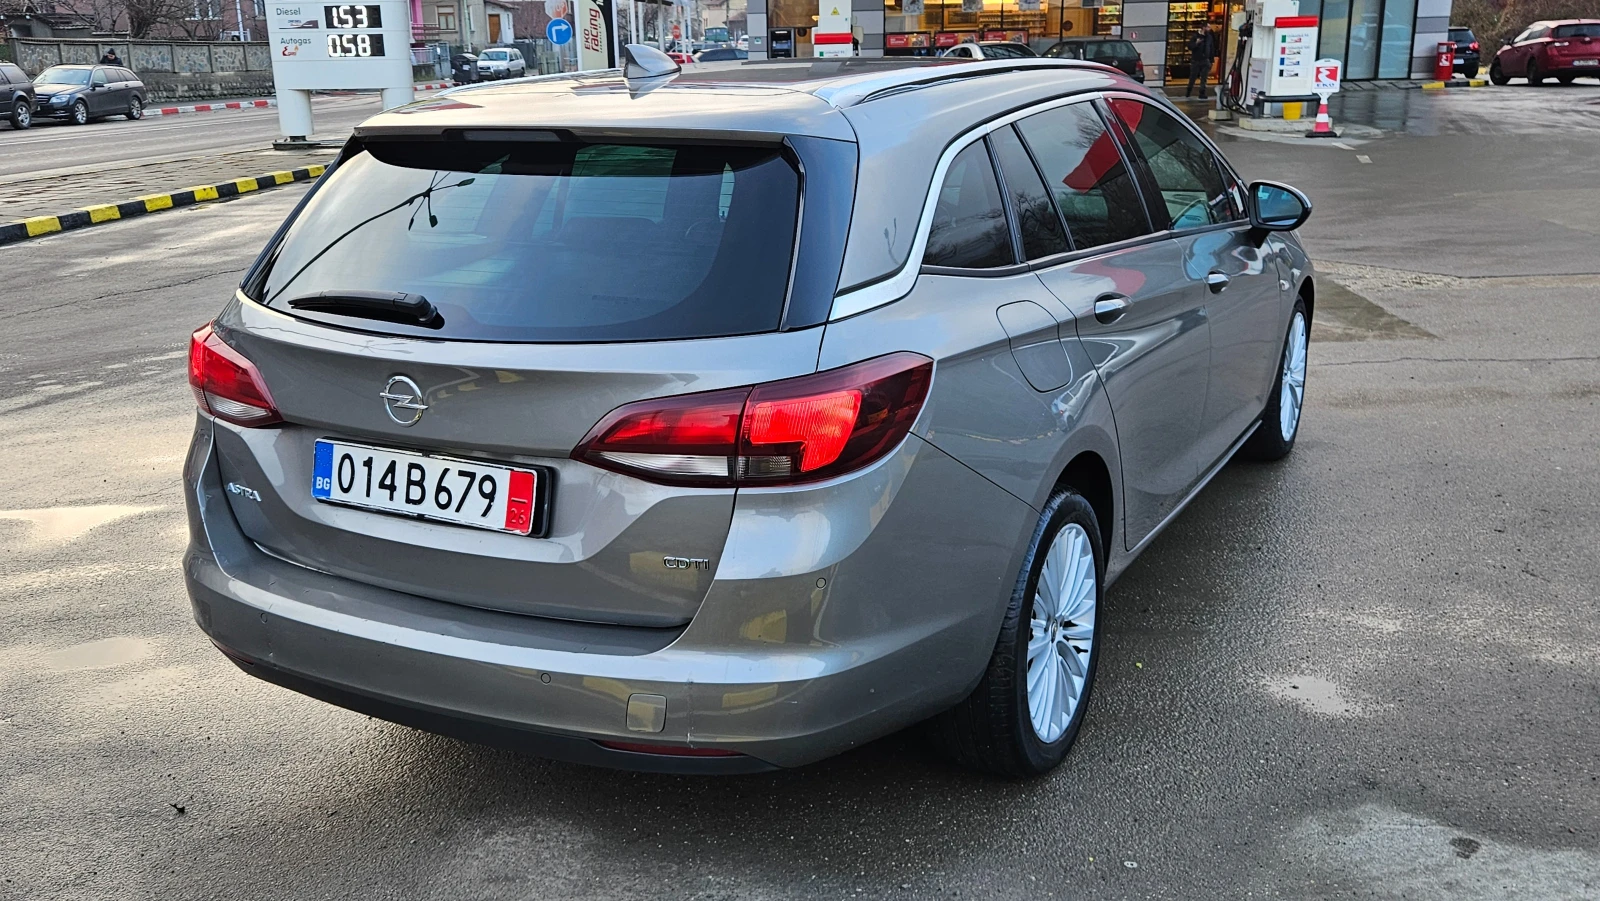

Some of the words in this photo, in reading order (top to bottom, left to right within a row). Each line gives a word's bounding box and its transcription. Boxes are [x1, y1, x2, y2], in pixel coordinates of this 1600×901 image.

[276, 8, 301, 16] Diesel
[589, 8, 600, 52] racing
[281, 37, 311, 46] Autogas
[227, 482, 261, 501] ASTRA
[315, 476, 331, 490] BG
[337, 453, 497, 517] 014B679
[510, 507, 526, 524] 26
[663, 556, 710, 571] CDTI
